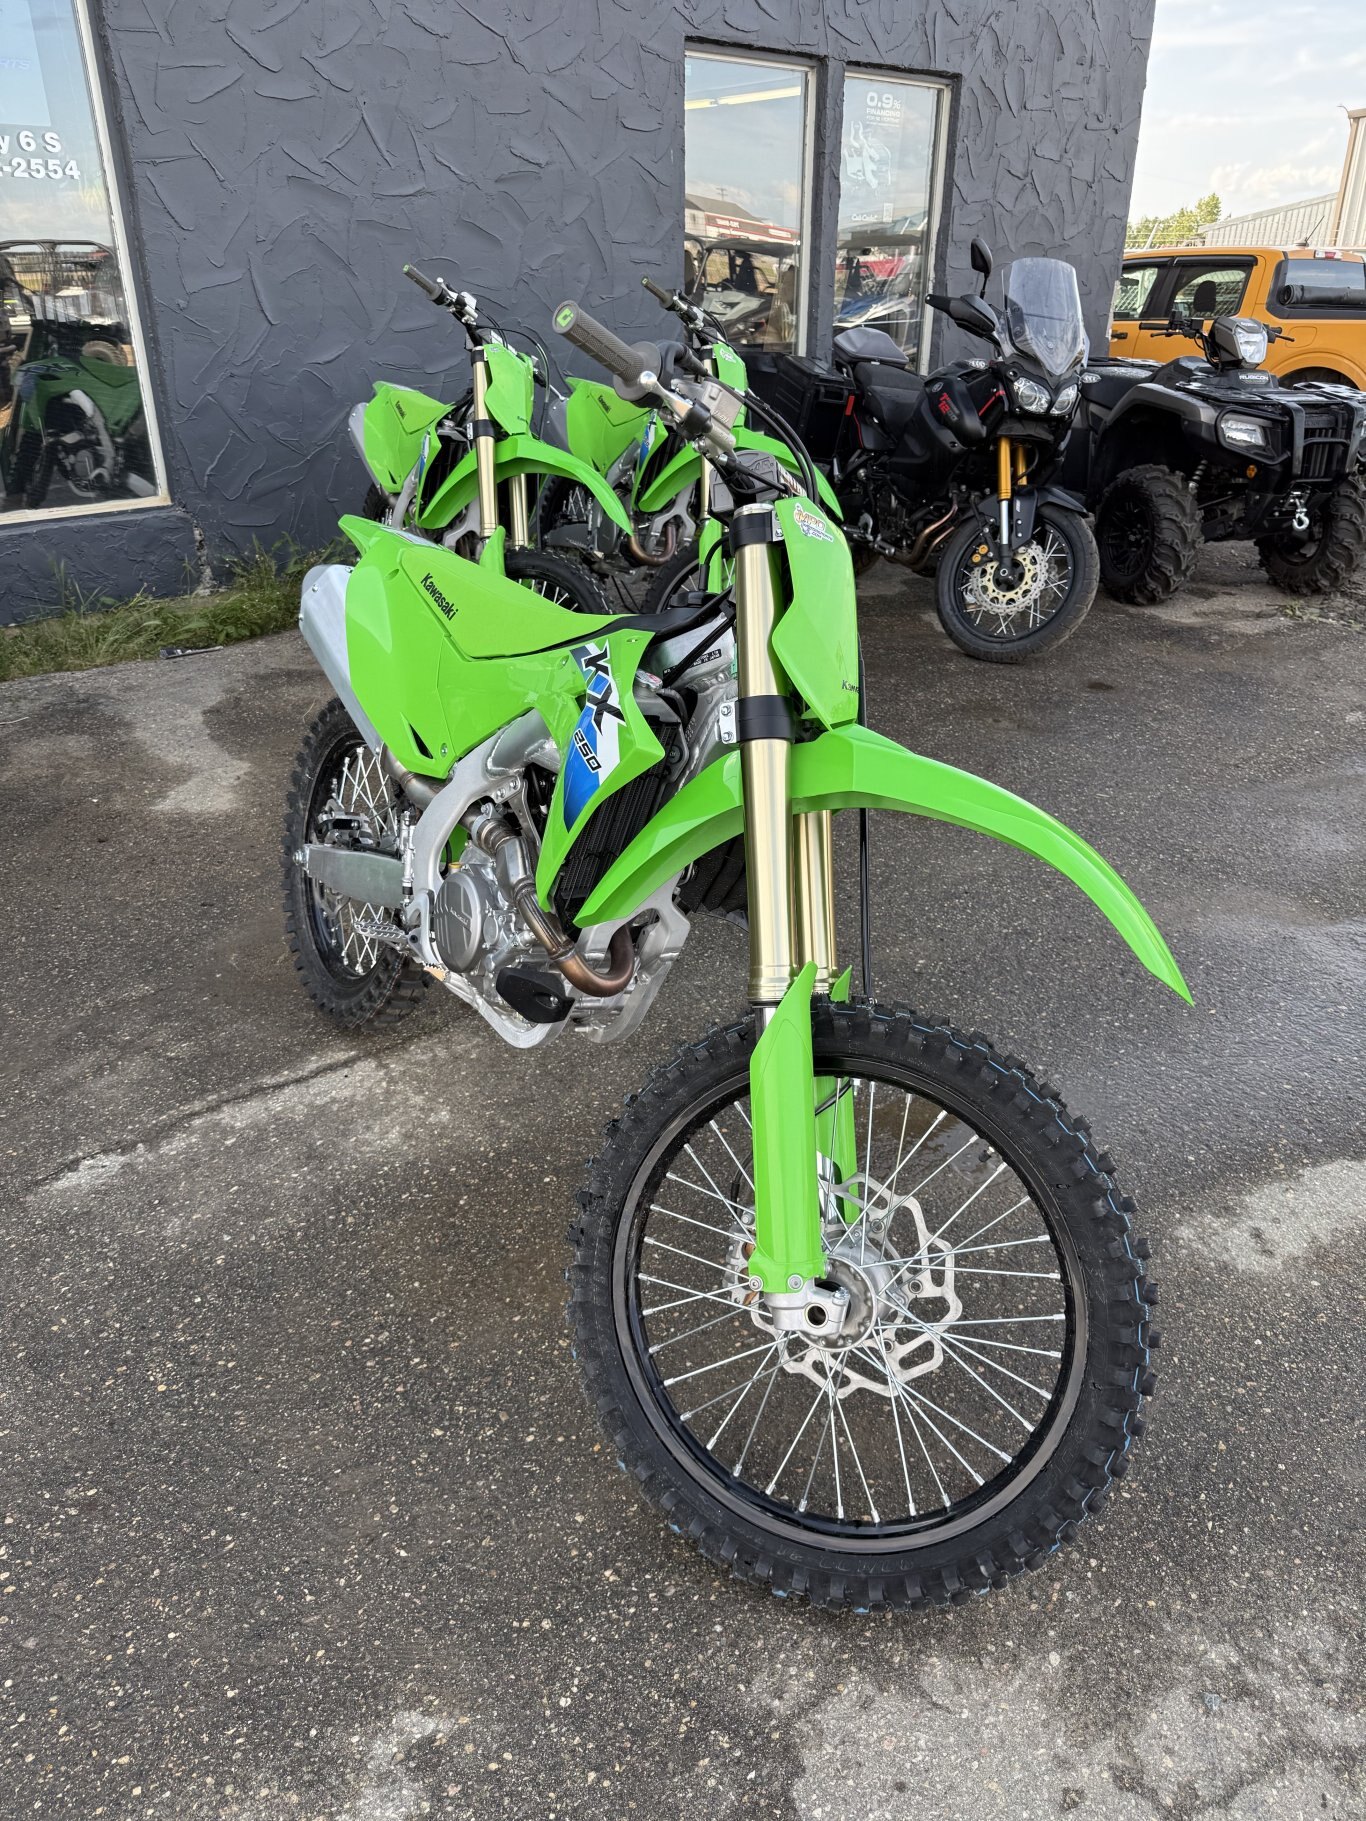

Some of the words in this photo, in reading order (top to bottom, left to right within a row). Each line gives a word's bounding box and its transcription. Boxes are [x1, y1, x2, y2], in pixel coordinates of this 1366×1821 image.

[18, 130, 37, 152] 6
[43, 131, 62, 153] S
[0, 157, 81, 180] -2554
[420, 572, 459, 621] Kawasaki
[583, 641, 626, 737] KX
[574, 728, 603, 773] 250
